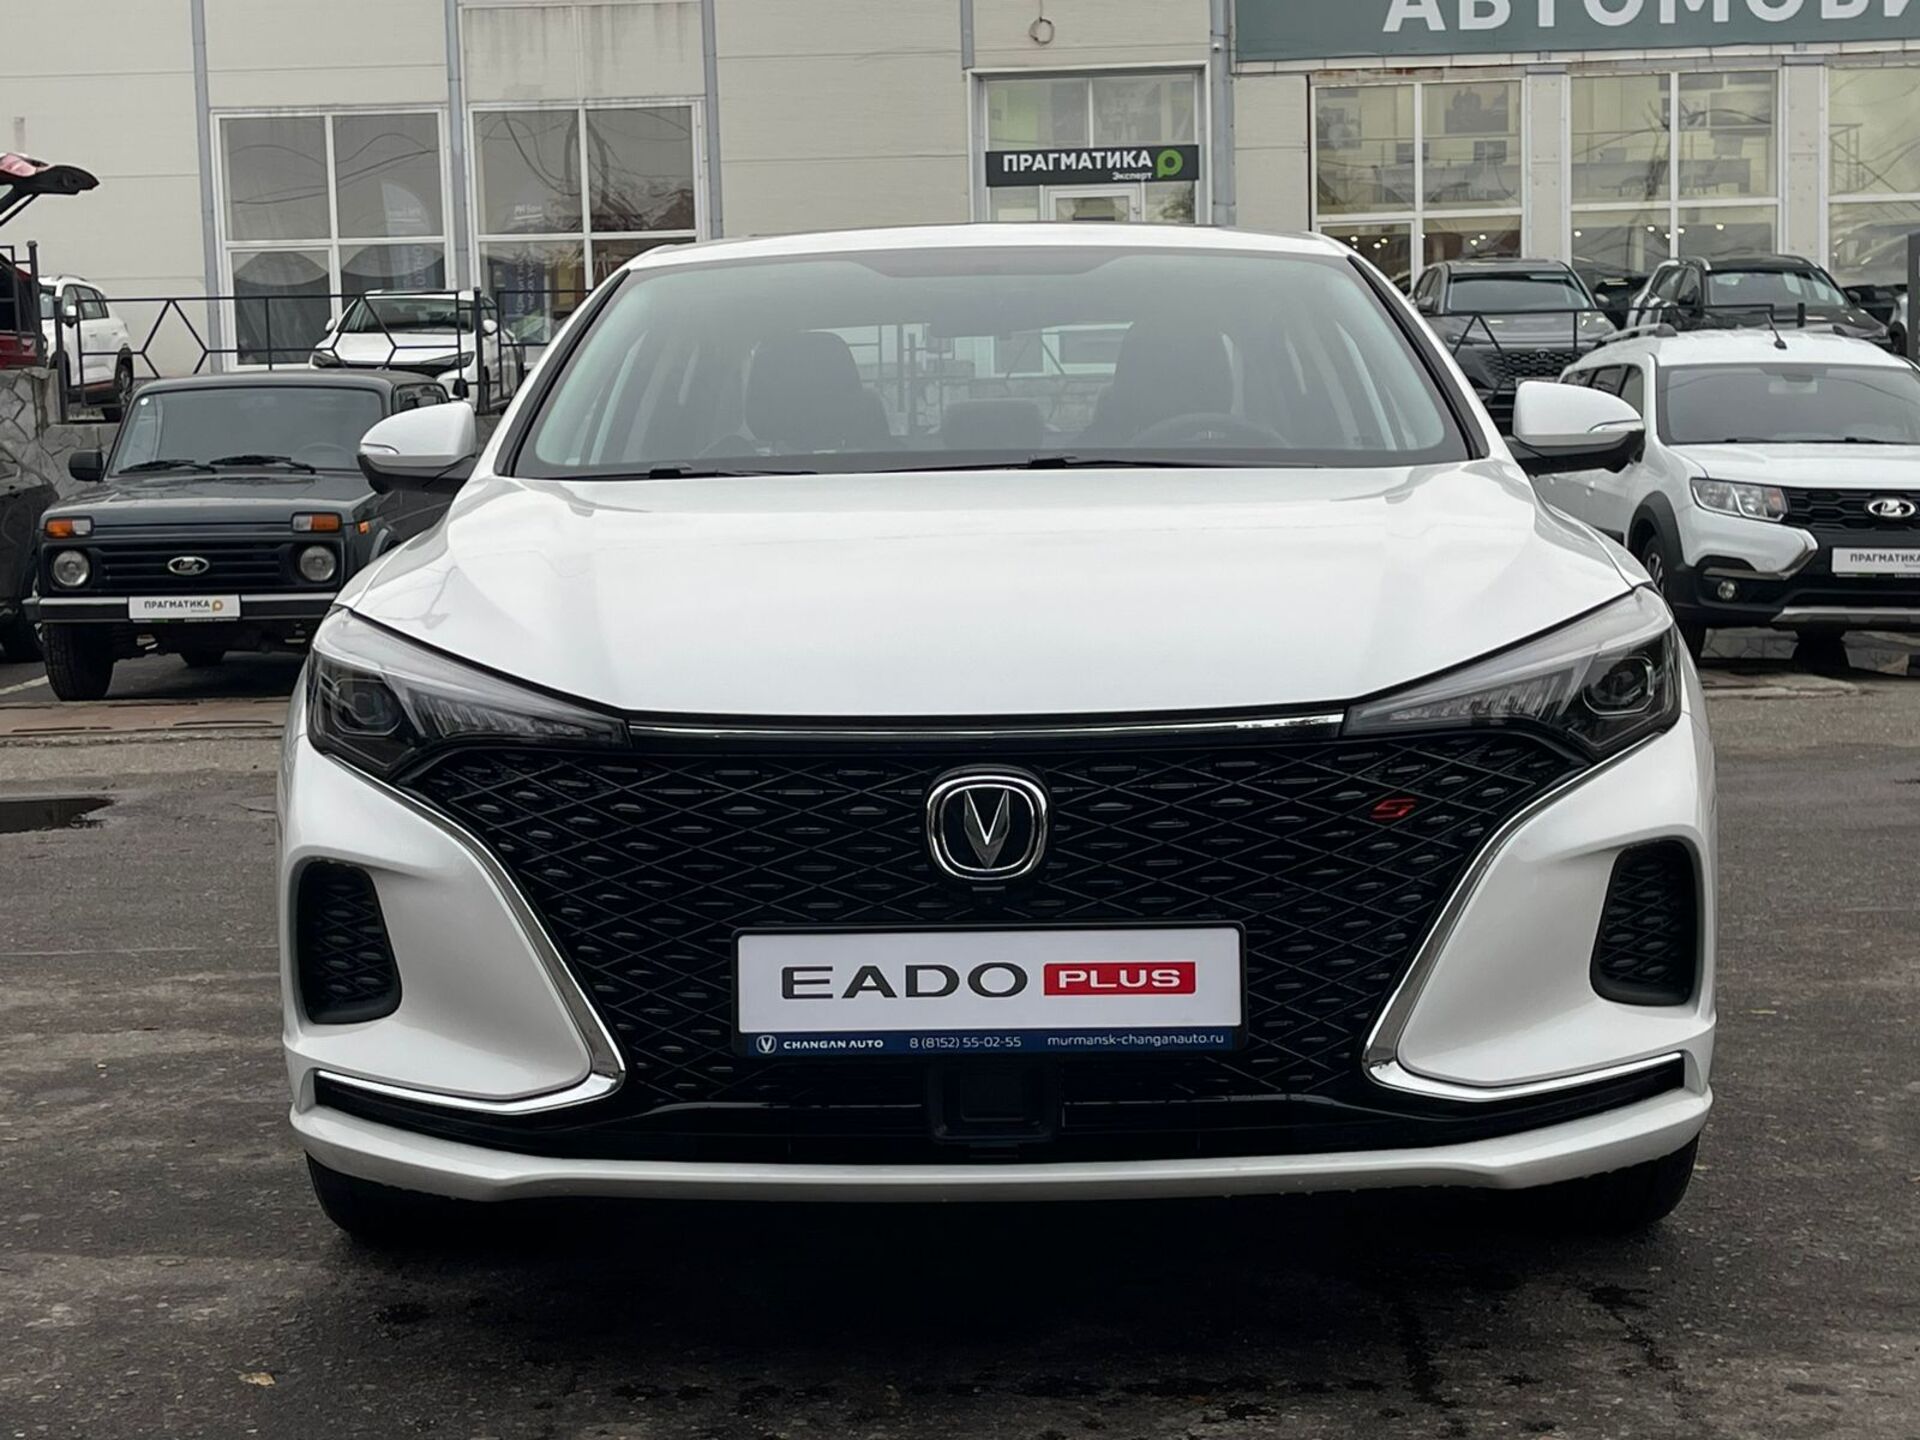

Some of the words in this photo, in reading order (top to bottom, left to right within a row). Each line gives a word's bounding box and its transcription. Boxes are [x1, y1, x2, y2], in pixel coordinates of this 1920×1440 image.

[1382, 0, 1920, 33] АВТО
[1002, 150, 1153, 172] ПРАГМАТИКА
[1112, 172, 1152, 181] Эксперт
[144, 600, 210, 609] ПРАГМАТИКА
[781, 961, 1029, 999] EADO
[1058, 968, 1181, 989] PLUS
[783, 1039, 846, 1050] CHANGAN
[848, 1039, 884, 1049] AUTO
[909, 1037, 919, 1048] 8
[921, 1036, 960, 1050] (8152)
[962, 1036, 1022, 1048] 55-02-55
[1047, 1032, 1224, 1048] murmansk-changanauto.ru
